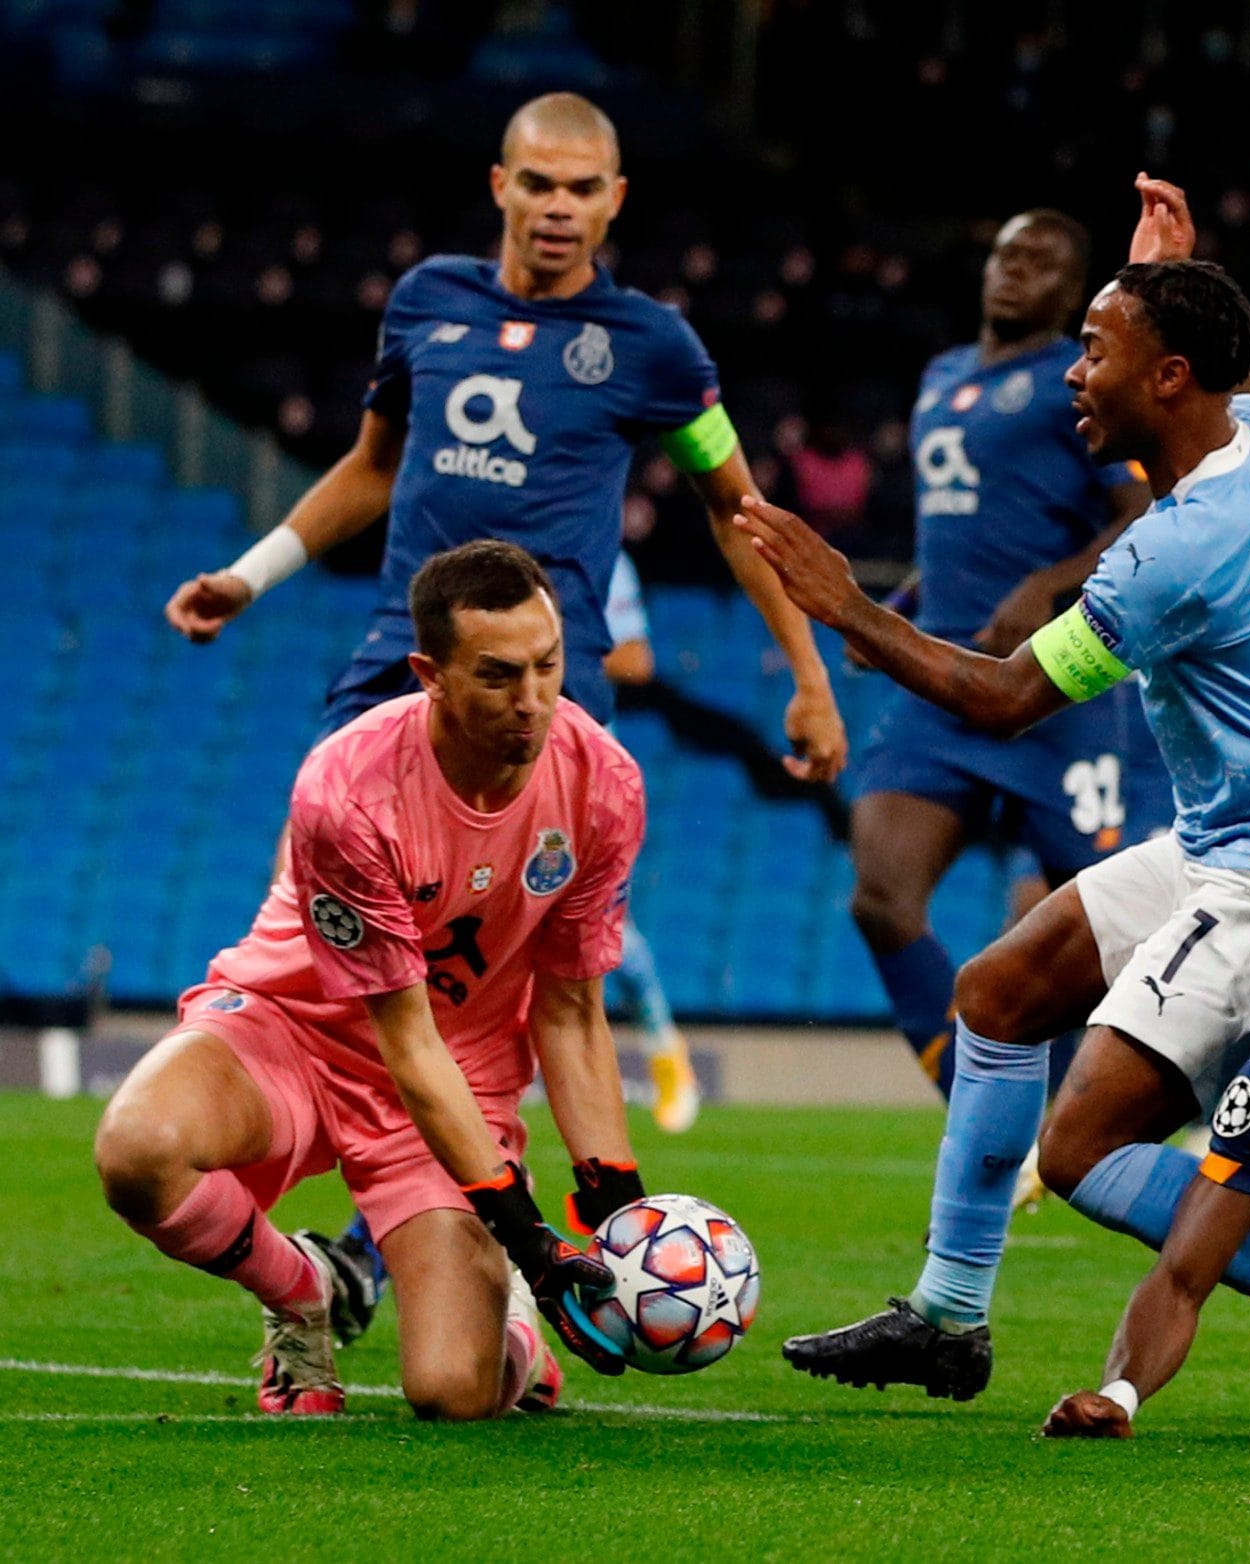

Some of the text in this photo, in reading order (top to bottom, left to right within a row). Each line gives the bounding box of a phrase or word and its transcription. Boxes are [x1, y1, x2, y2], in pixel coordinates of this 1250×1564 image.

[434, 445, 527, 487] altice
[1067, 629, 1083, 648] NO
[1081, 648, 1096, 665] TO
